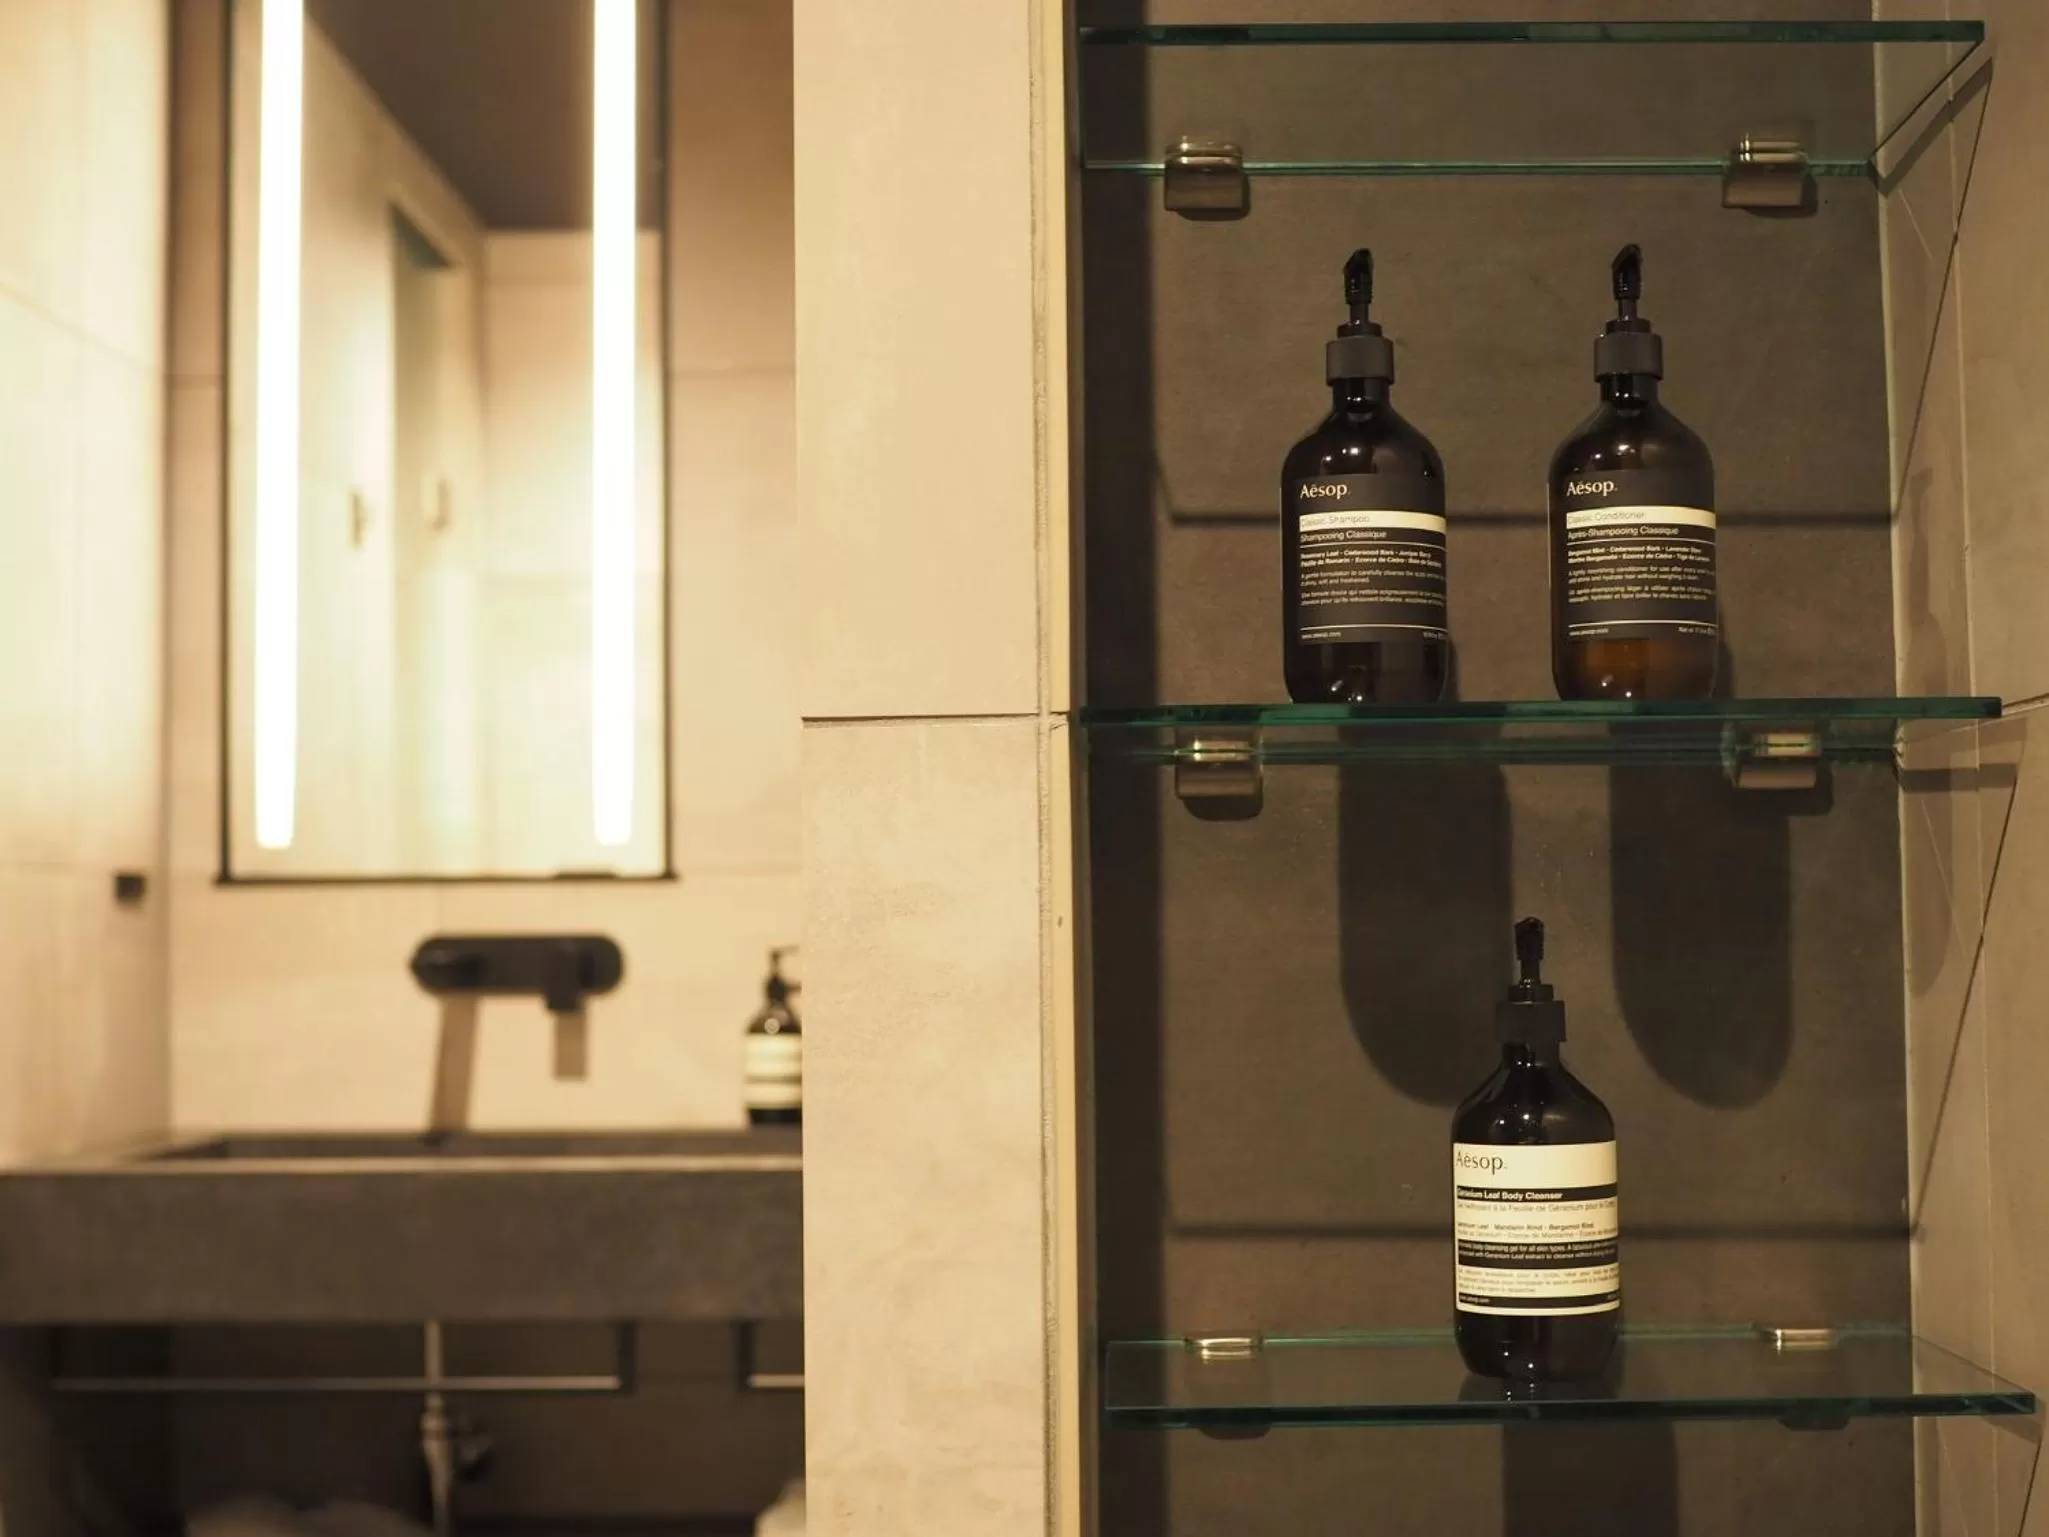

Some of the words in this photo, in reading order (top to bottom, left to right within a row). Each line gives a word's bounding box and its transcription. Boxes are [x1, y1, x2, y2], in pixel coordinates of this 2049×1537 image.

[1329, 515, 1370, 524] Shampoo
[1594, 512, 1644, 521] Conditioner
[1640, 526, 1679, 535] Classique
[1300, 533, 1344, 543] Shampooing
[1346, 530, 1387, 540] Classique
[1485, 1191, 1500, 1199] Leaf
[1502, 1191, 1523, 1201] Body
[1525, 1192, 1563, 1200] Cleanser
